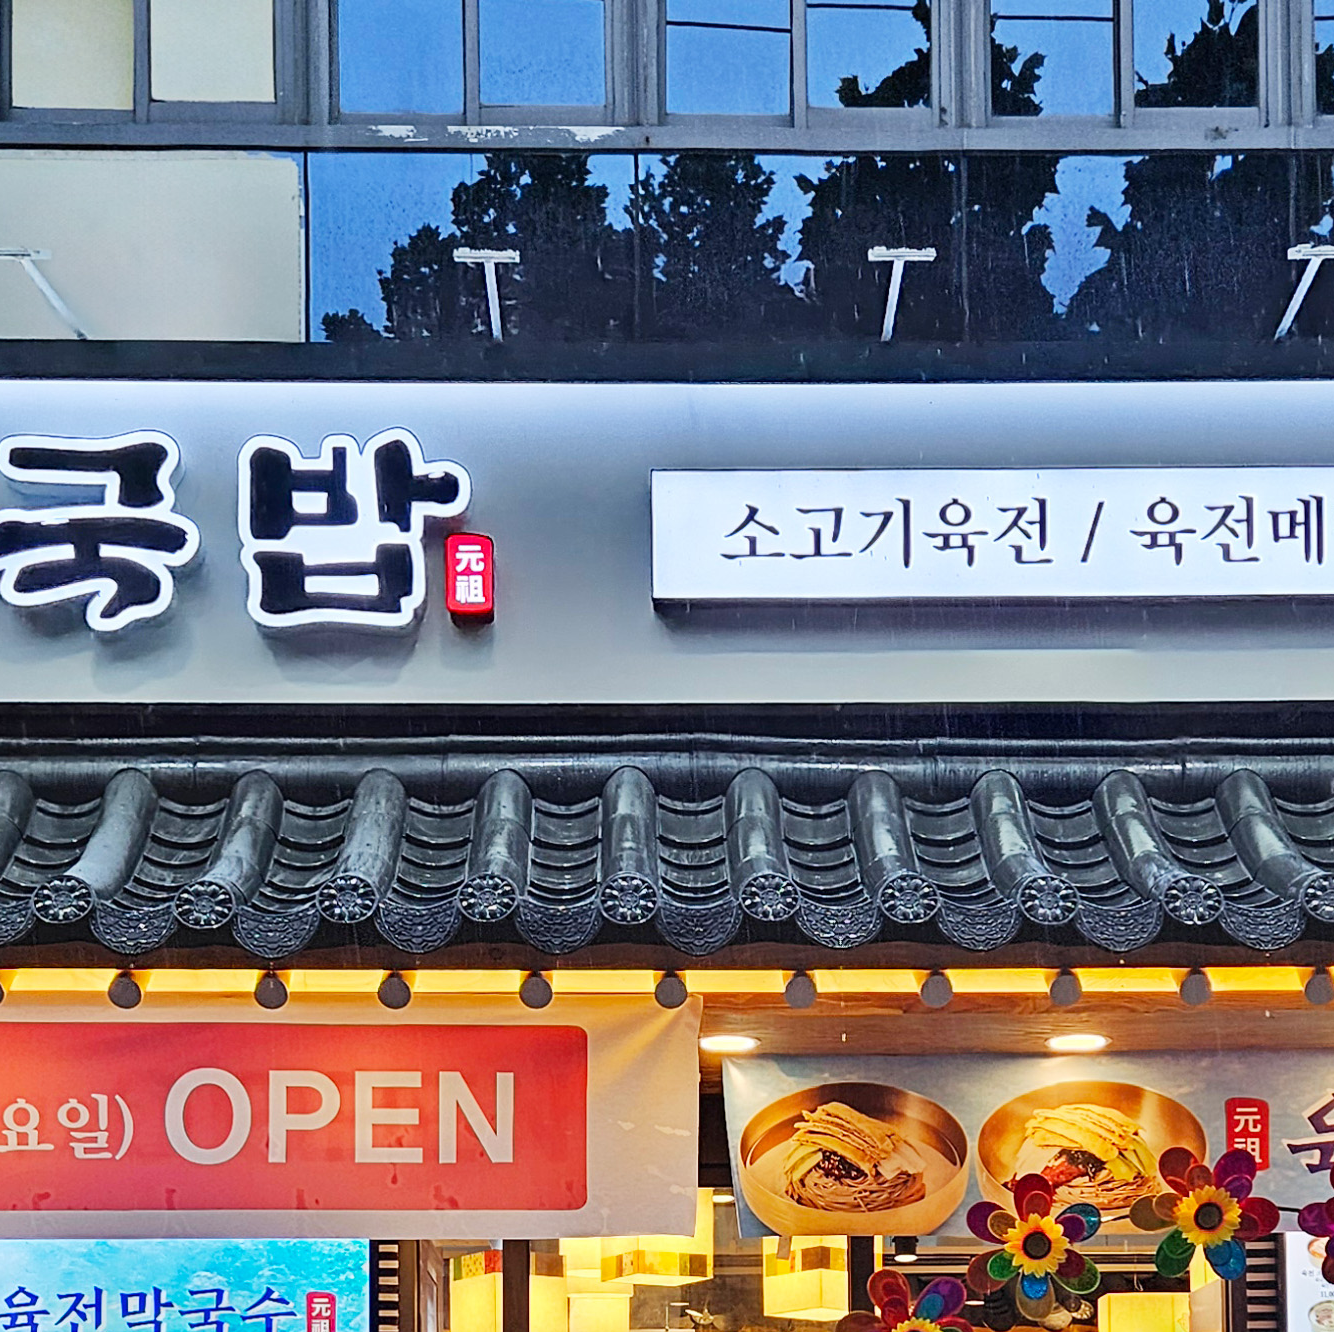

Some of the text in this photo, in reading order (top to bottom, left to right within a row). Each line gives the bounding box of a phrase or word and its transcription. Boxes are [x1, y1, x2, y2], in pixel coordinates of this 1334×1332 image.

[720, 496, 1054, 568] 소고기육전
[451, 545, 488, 606] 元祖
[163, 1067, 515, 1165] OPEN
